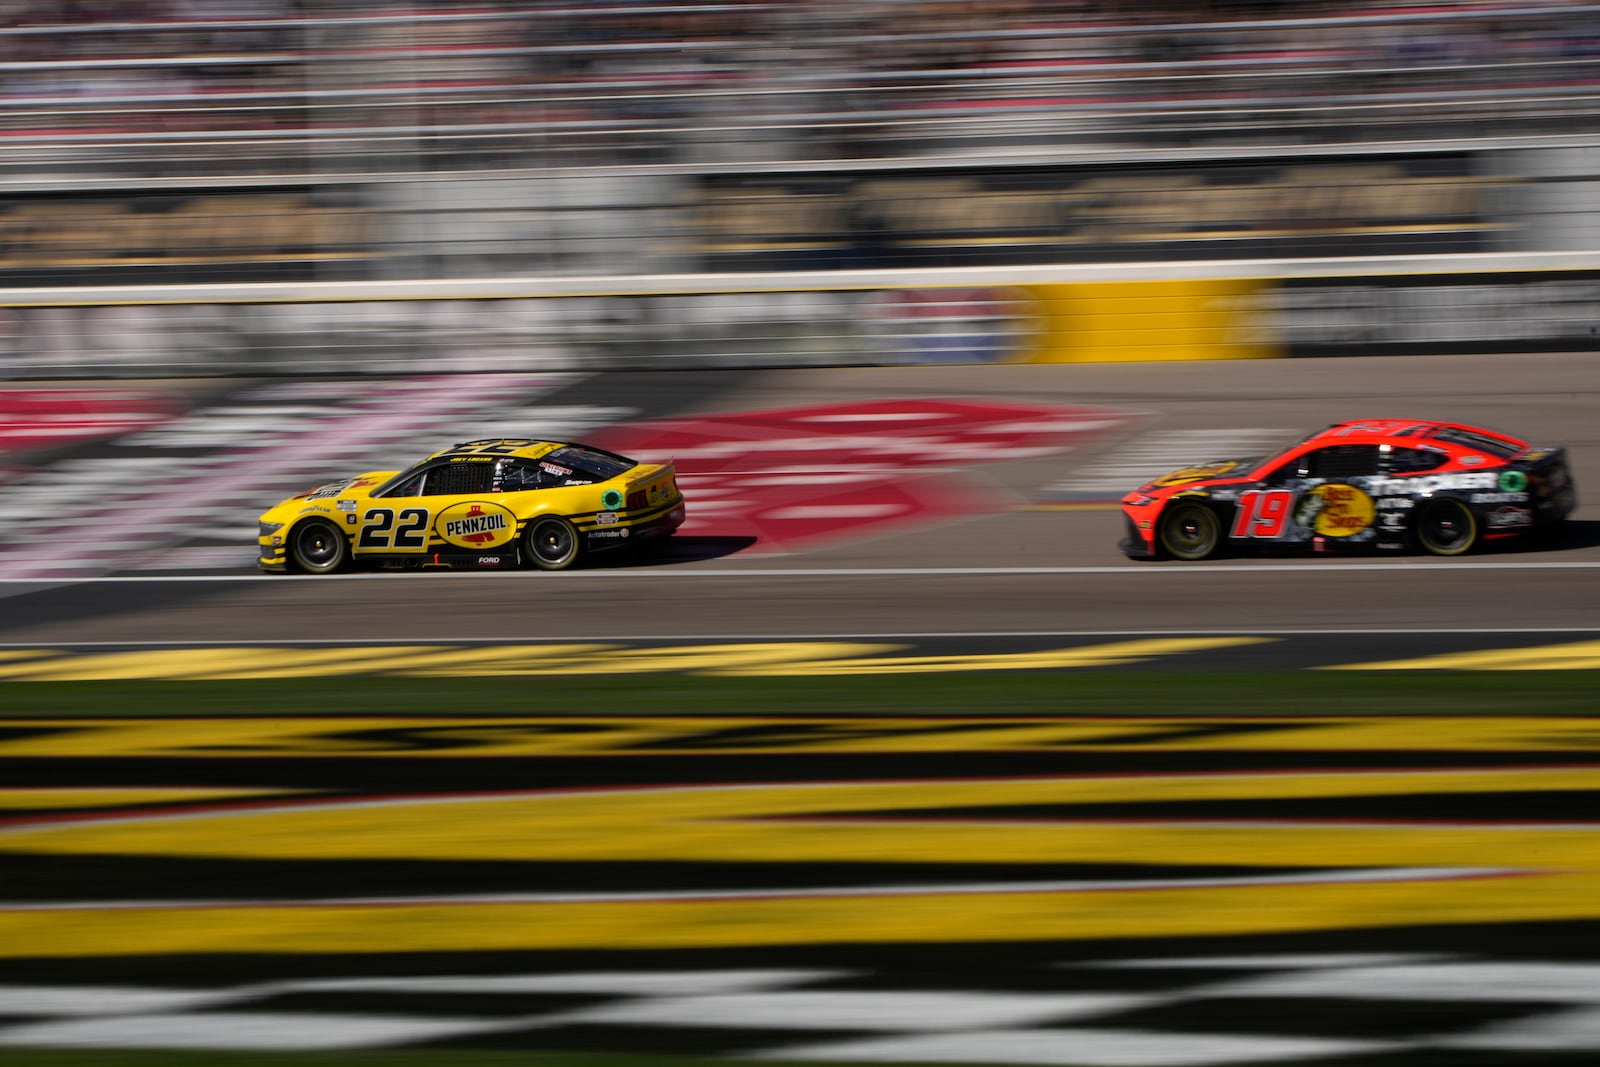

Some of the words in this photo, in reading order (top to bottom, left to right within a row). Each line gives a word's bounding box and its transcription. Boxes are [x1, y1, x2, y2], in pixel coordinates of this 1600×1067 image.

[358, 508, 429, 549] 22
[446, 514, 506, 537] PENNZOIL
[1231, 490, 1296, 539] 19
